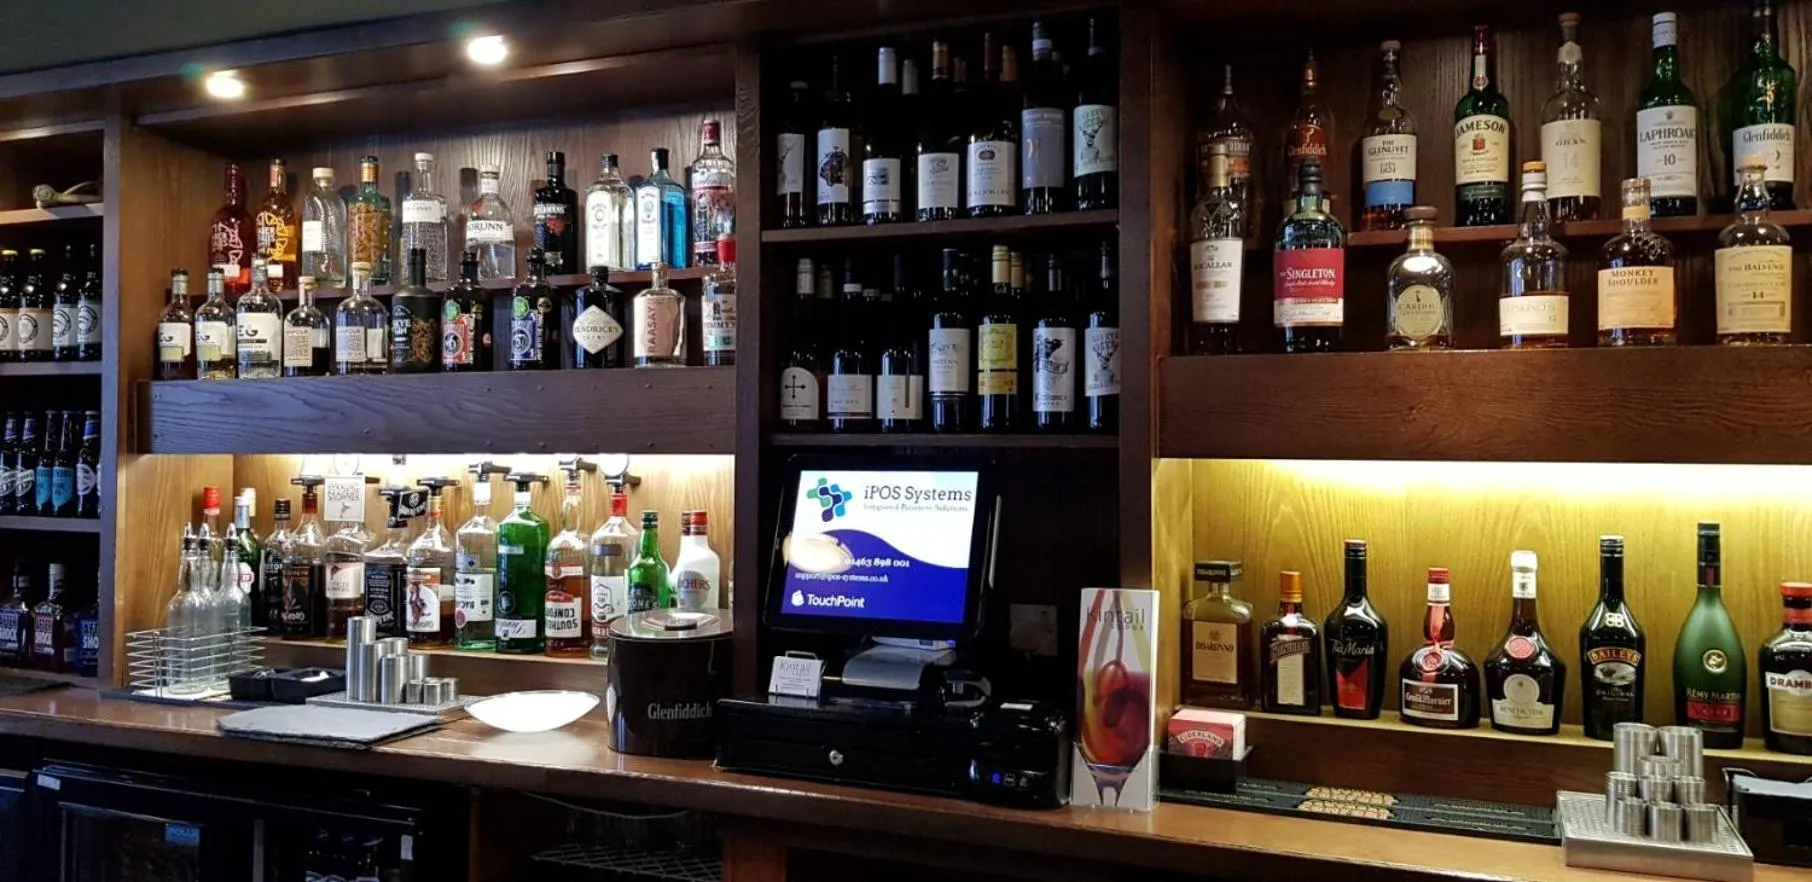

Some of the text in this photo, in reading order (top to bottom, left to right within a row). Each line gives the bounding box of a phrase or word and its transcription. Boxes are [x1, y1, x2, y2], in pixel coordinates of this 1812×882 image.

[1455, 119, 1506, 139] JAMESON
[1368, 145, 1409, 156] GLENLIVET
[1663, 153, 1677, 167] 10
[1286, 267, 1336, 281] SINGLETON
[1611, 269, 1656, 278] MONKEY
[1608, 277, 1659, 288] SHOULDER
[647, 303, 658, 354] RAASAY
[864, 485, 972, 504] iPOS Systems
[873, 557, 891, 568] 898
[893, 559, 910, 568] 001
[807, 593, 865, 608] TouchPoint
[1196, 641, 1235, 653] DISARONNO
[1349, 639, 1376, 656] Maria
[1590, 649, 1639, 664] BAILEYS
[647, 702, 713, 721] Glenfiddich
[1178, 731, 1223, 746] CIDERLAND
